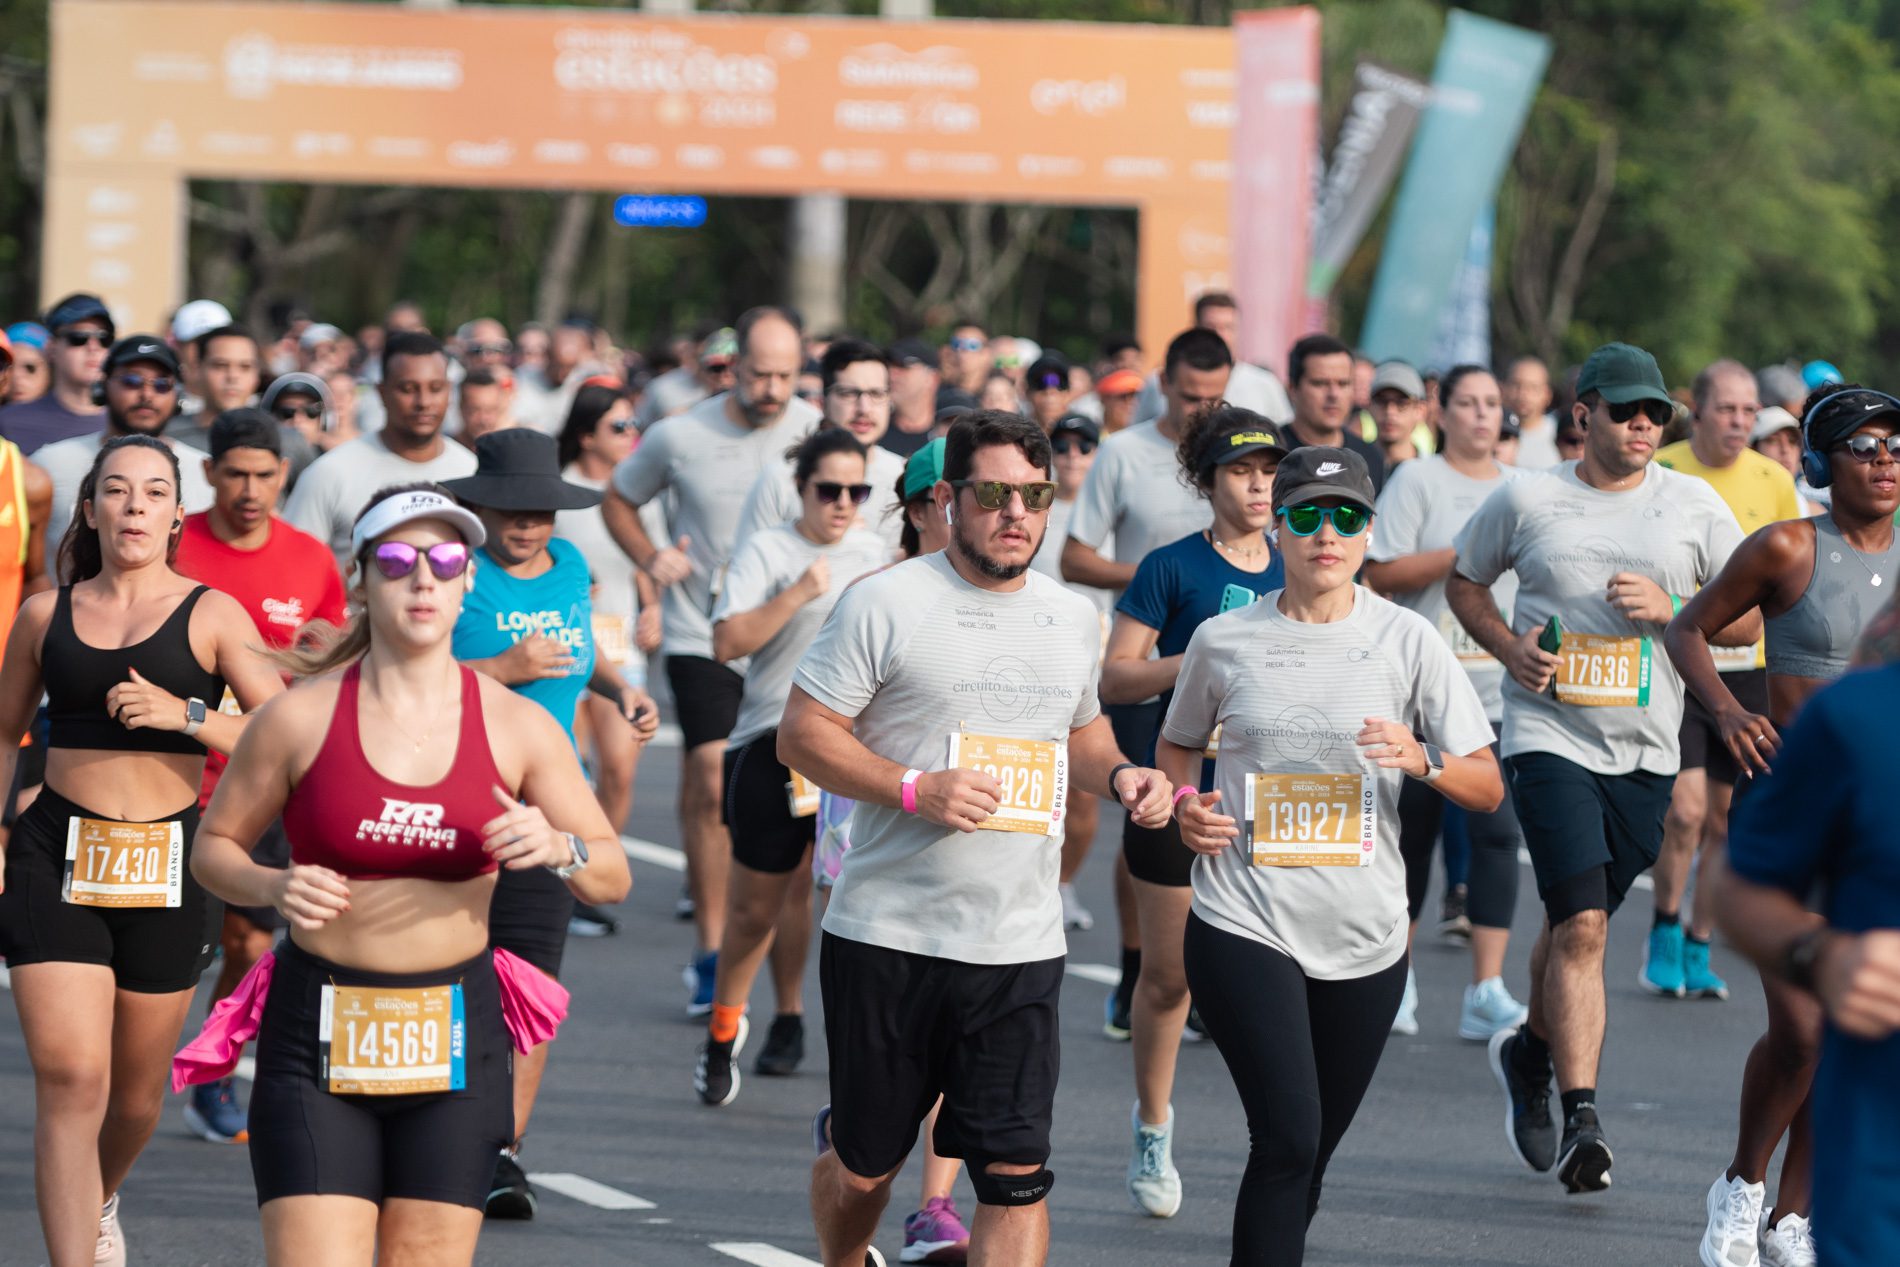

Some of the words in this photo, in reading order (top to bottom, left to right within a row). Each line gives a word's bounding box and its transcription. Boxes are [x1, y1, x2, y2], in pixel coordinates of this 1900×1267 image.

[1321, 462, 1341, 471] NIKE
[496, 610, 564, 634] LONGE
[1265, 647, 1305, 656] SulAmérica
[1265, 661, 1285, 669] REDE
[1568, 652, 1630, 687] 17636
[1640, 656, 1649, 689] VERDE
[952, 679, 1001, 693] circuito
[1002, 684, 1018, 693] das
[1018, 683, 1073, 700] estações
[1245, 725, 1293, 739] circuito
[1294, 730, 1309, 740] das
[1054, 760, 1065, 808] BRANCO
[379, 797, 445, 827] RR
[1268, 801, 1348, 841] 13927
[1364, 790, 1373, 839] BRANCO
[355, 830, 456, 851] RUNNING
[358, 818, 457, 842] RAFINHA
[86, 844, 160, 883] 17430
[169, 841, 180, 887] BRANCO
[346, 1018, 438, 1067] 14569
[452, 1020, 463, 1059] AZUL
